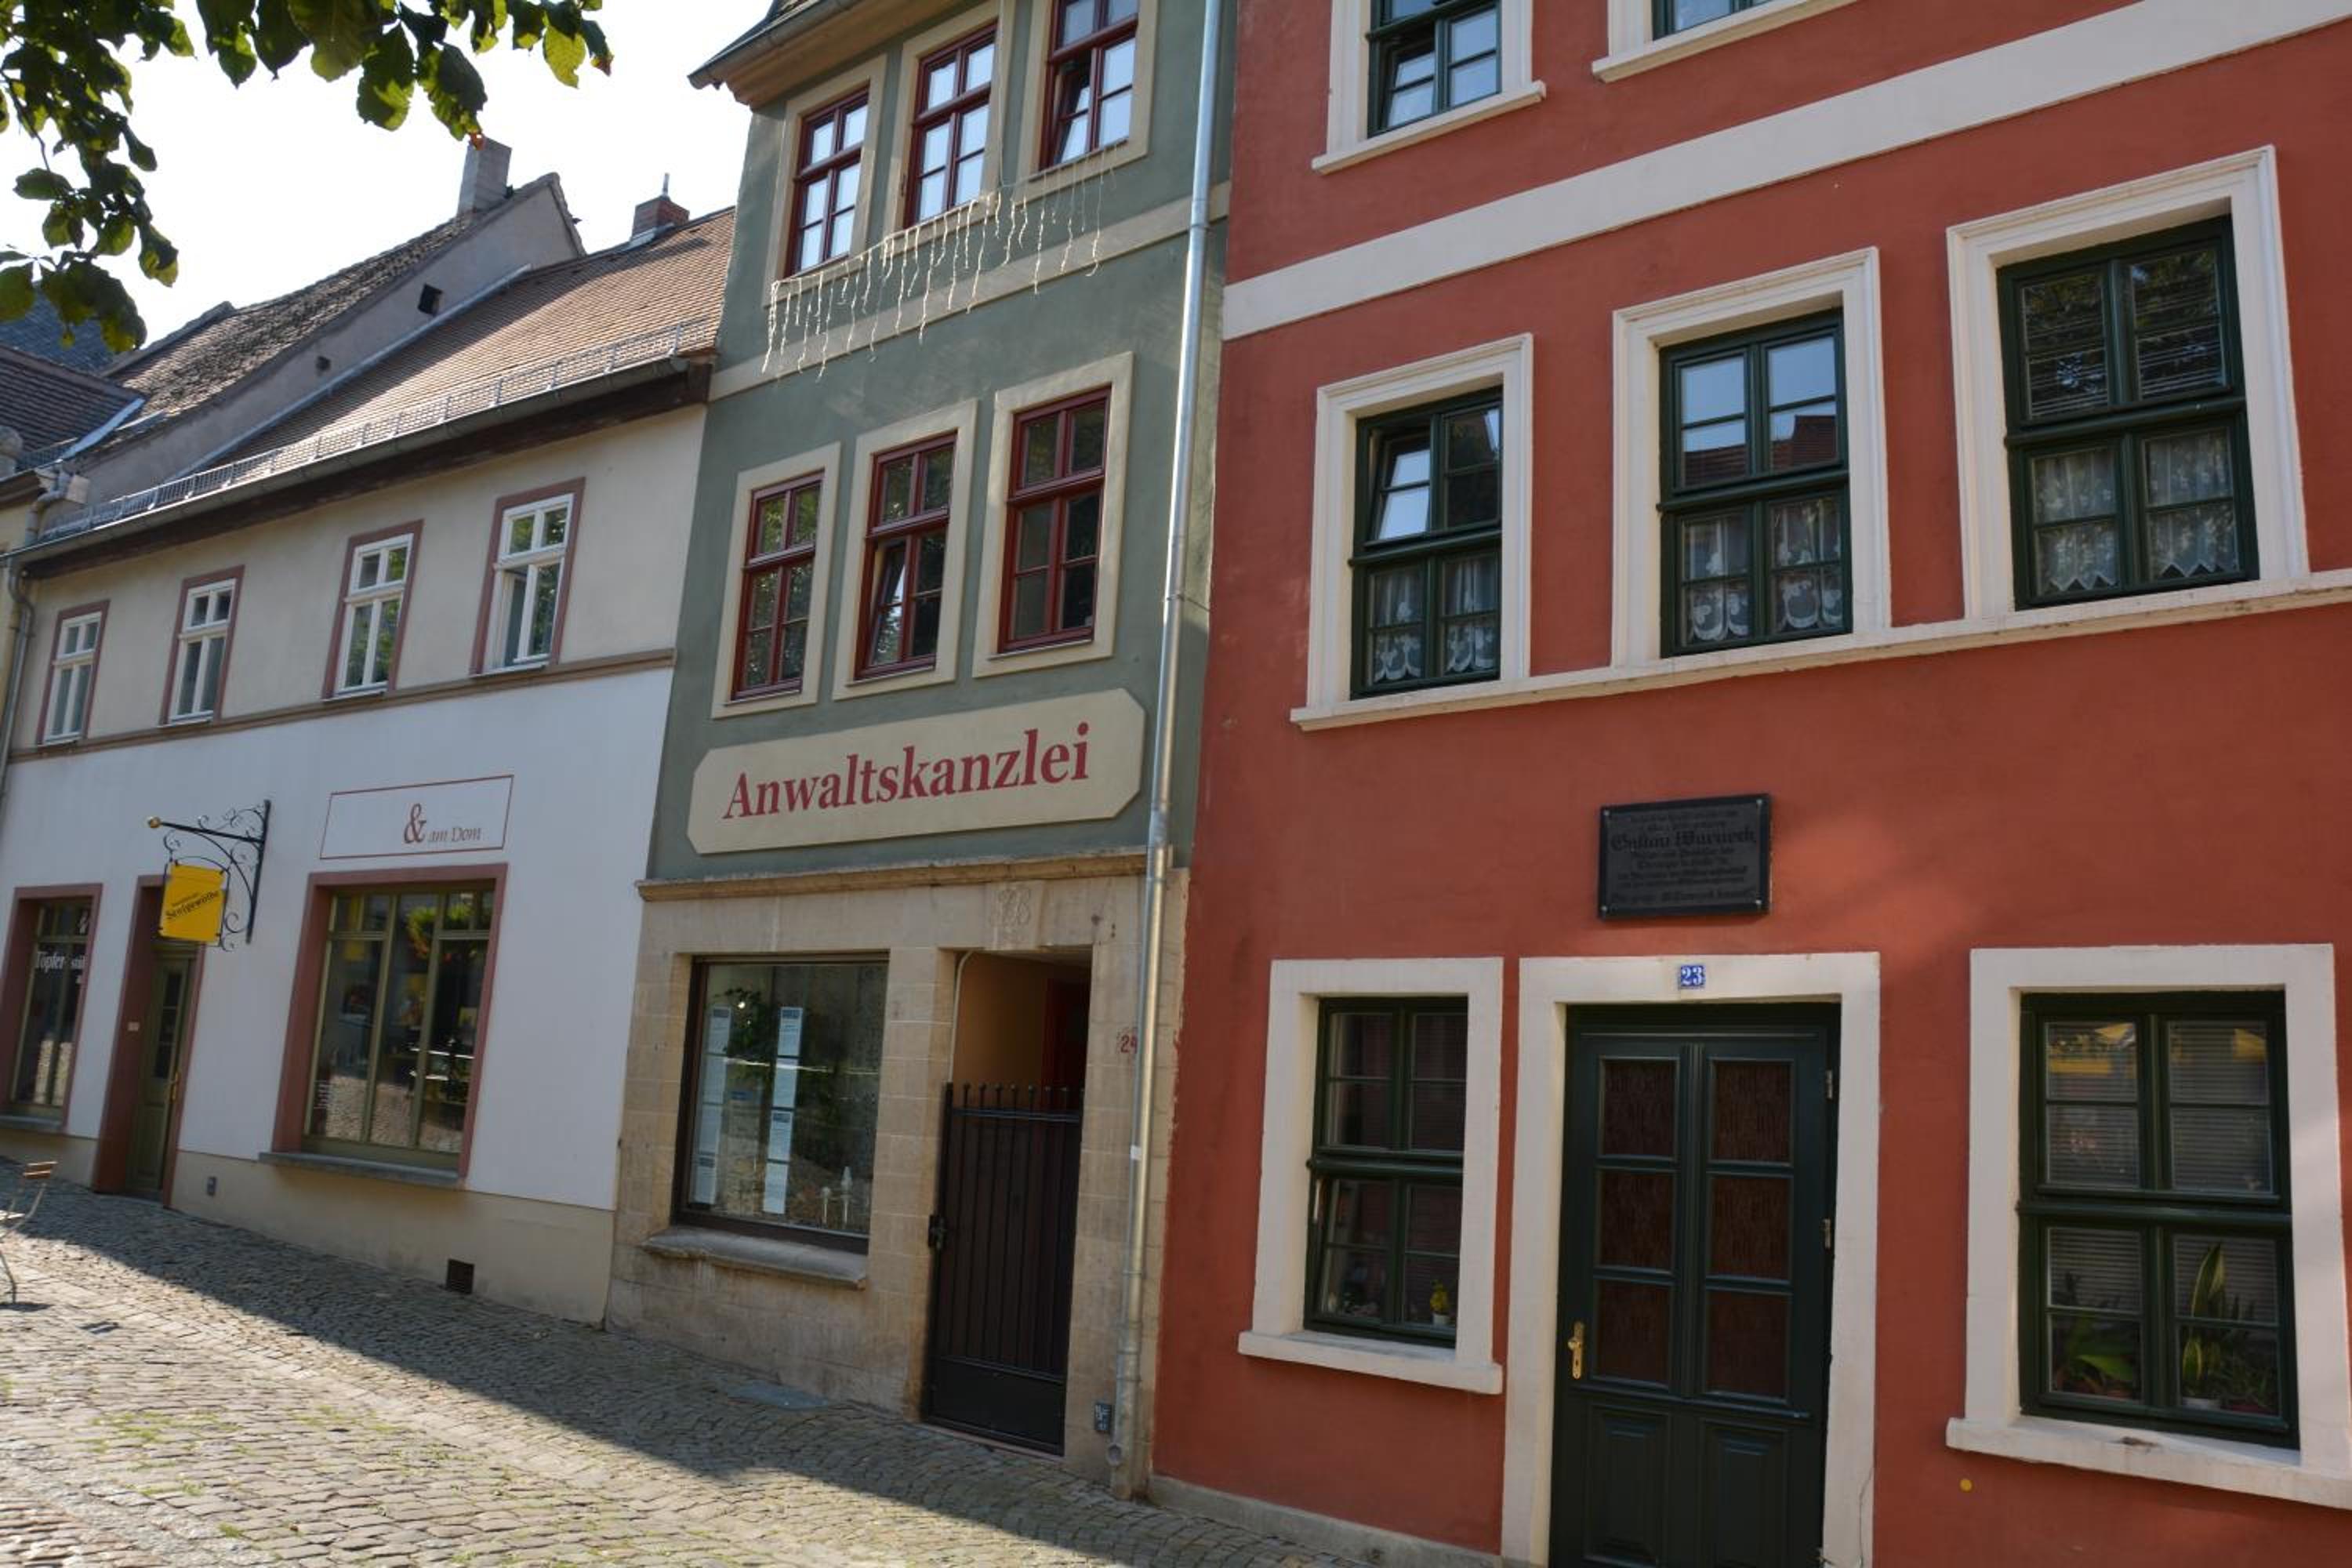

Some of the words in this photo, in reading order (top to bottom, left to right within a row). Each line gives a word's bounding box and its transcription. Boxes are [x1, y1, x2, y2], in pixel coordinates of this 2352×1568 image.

[722, 721, 1090, 820] Anwaltskanzlei
[404, 803, 427, 844] &
[452, 826, 482, 842] Dom
[1681, 966, 1703, 985] 23
